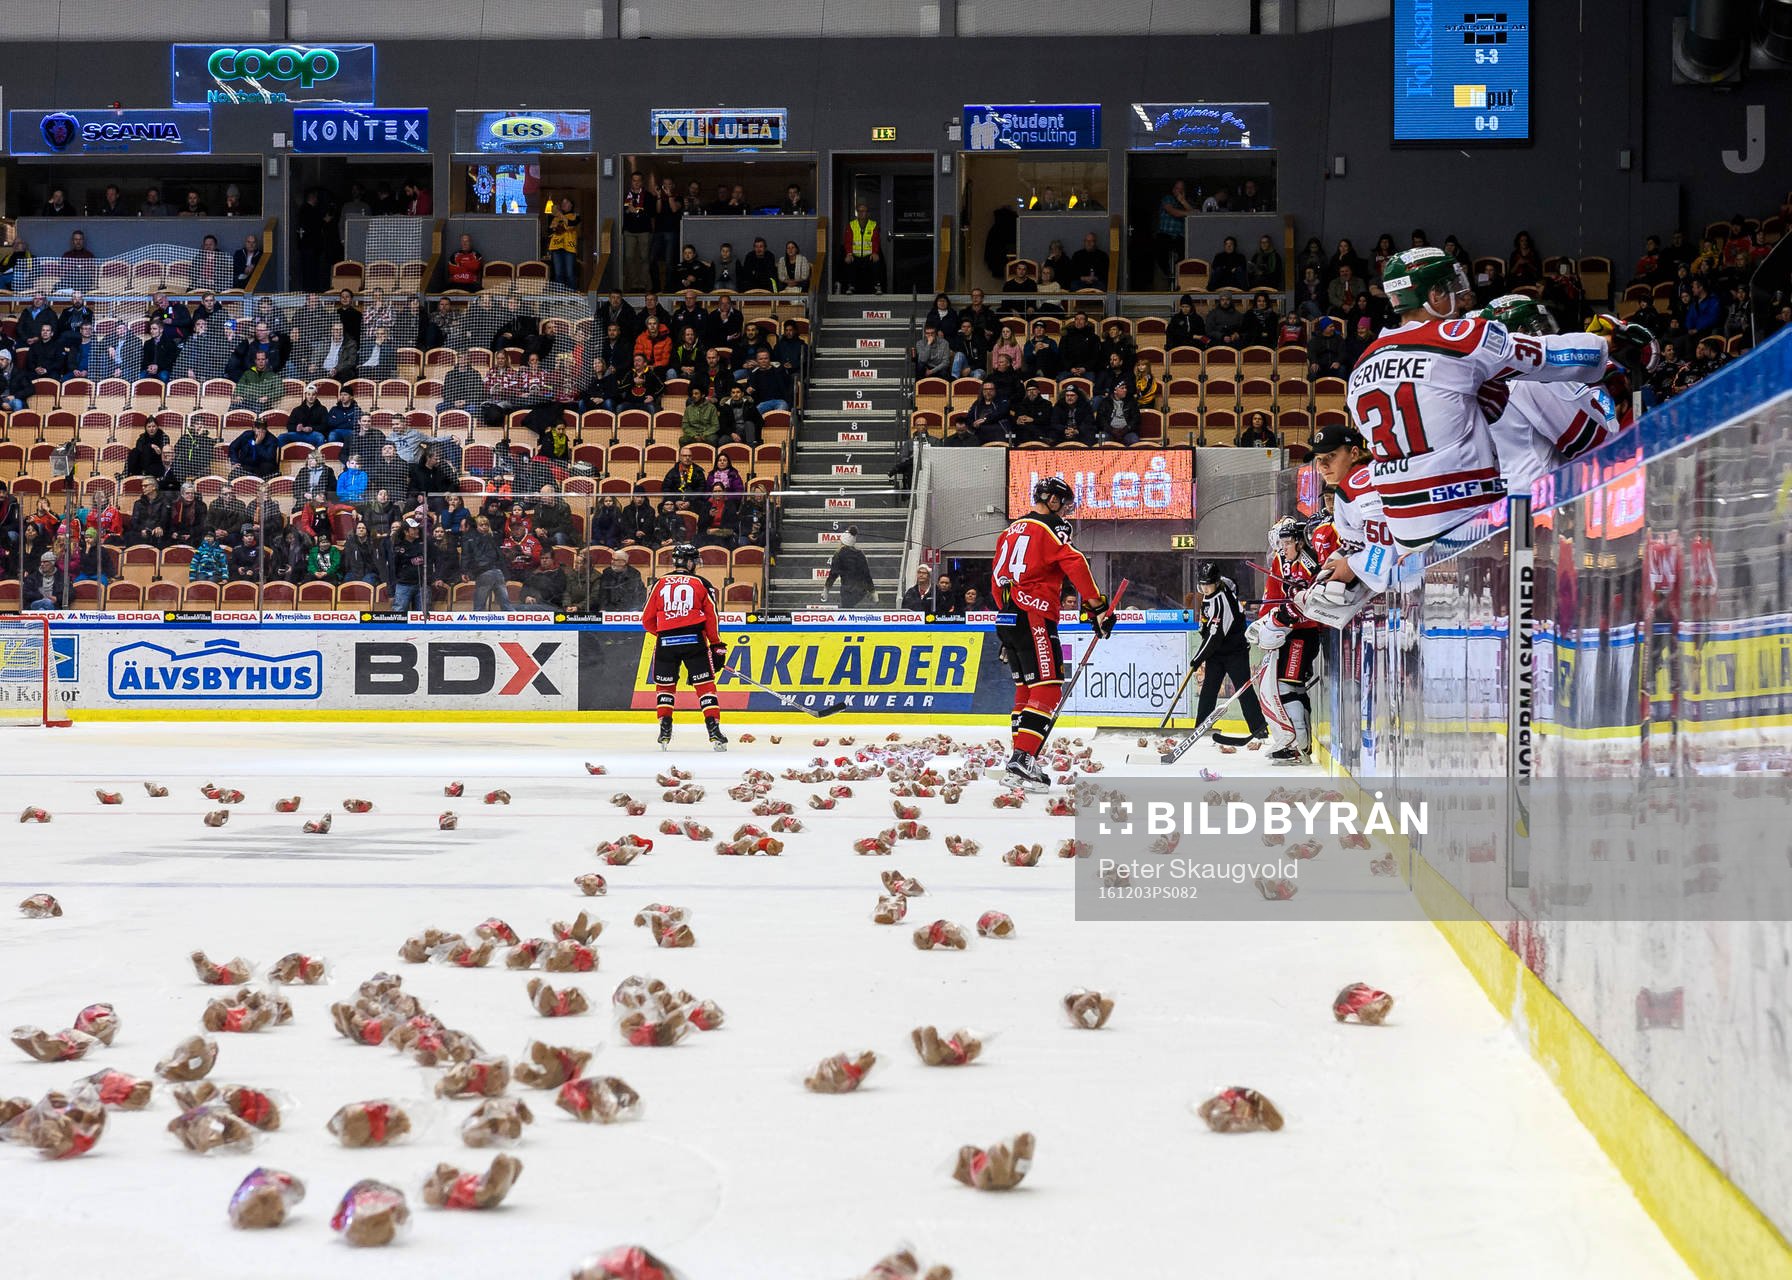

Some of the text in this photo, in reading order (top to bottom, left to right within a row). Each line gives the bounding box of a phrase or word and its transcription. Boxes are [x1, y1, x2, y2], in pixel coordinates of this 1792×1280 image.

[1475, 48, 1499, 65] 5-3
[207, 48, 340, 89] coop
[714, 118, 773, 139] LULEÅ
[1001, 113, 1065, 129] Student
[1475, 115, 1499, 131] 0-0
[82, 122, 182, 142] SCANIA
[302, 120, 420, 141] KONTEX
[501, 122, 544, 137] LGS
[659, 118, 704, 145] XL
[1001, 127, 1077, 146] Consulting
[1721, 104, 1766, 174] J
[866, 311, 888, 319] MAXI
[1513, 336, 1543, 367] 31
[860, 359, 870, 368] 10
[856, 390, 863, 399] 9
[846, 401, 868, 409] MAXI
[851, 422, 858, 431] 8
[1356, 381, 1434, 462] 31
[841, 433, 864, 441] MAXI
[845, 453, 852, 463] 7
[1431, 480, 1479, 503] SKF
[832, 521, 839, 530] 5
[1366, 520, 1394, 546] 50
[993, 534, 1031, 587] 24
[1282, 562, 1291, 577] 3
[1015, 590, 1050, 611] SSAB
[80, 612, 161, 622] Myresjöhus BORGA
[213, 613, 257, 621] BORGA
[275, 613, 357, 622] Myresjöhus BORGA
[410, 613, 551, 622] BORGA Myresjöhus BORGA
[664, 609, 689, 621] SSAB
[718, 614, 743, 622] RGA
[794, 613, 922, 623] BORGA Myresjöhus BORGA
[967, 614, 996, 622] BORG
[717, 634, 969, 686] ÅKLÄDER
[118, 660, 313, 690] ÄLVSBYHUS
[355, 642, 562, 695] BDX
[1078, 662, 1182, 707] Tandlaget
[780, 693, 936, 707] WORKWEAR
